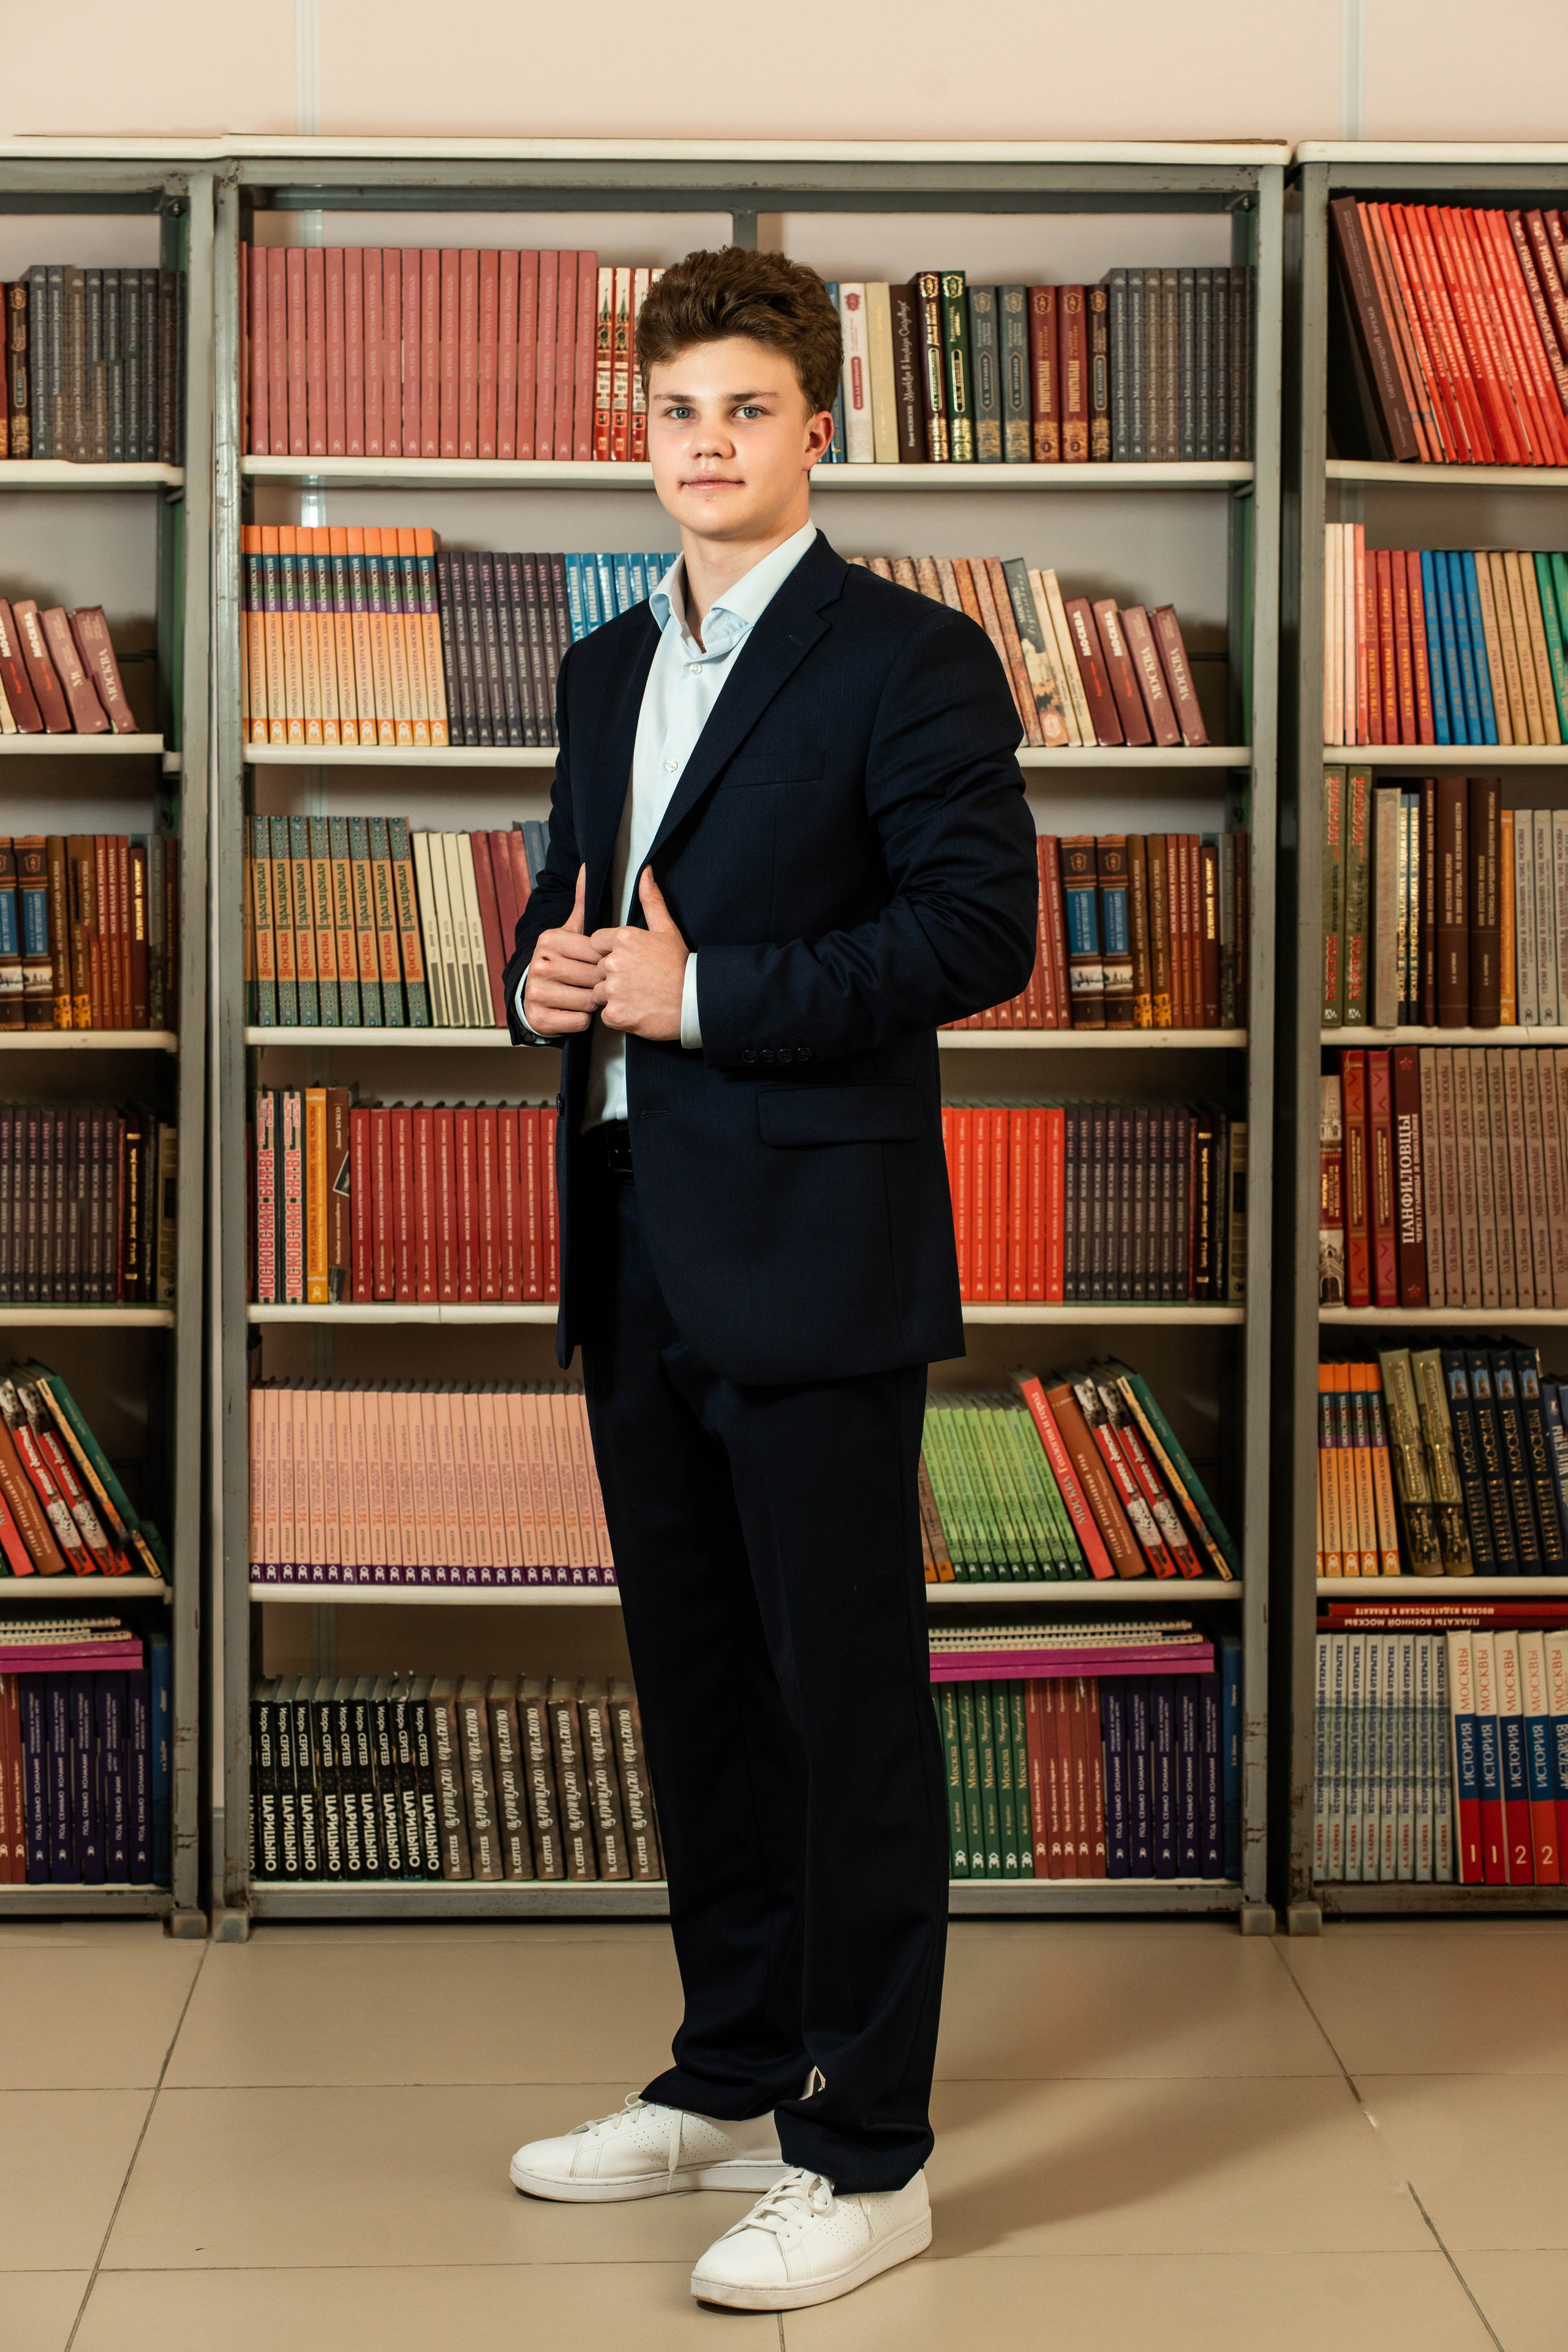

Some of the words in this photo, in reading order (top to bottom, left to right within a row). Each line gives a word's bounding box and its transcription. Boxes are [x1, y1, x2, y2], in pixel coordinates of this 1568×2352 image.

[569, 567, 582, 622] БЕЛОКАМЕННАЯ
[585, 567, 598, 622] БЕЛОКАМЕННАЯ
[24, 612, 42, 658] МОСКВА
[1073, 611, 1092, 656] МОСКВА
[1104, 611, 1123, 656] МОСКВА
[99, 648, 118, 702] МОСКВА
[460, 646, 469, 676] ПОДВИГ
[1141, 647, 1164, 699] МОСКВА
[1170, 648, 1189, 701] МОСКВА
[1326, 777, 1340, 845] МОСКВОЙ
[1351, 777, 1365, 845] МОСКВОЙ
[1325, 936, 1338, 1000] РАЗГРОМ
[1350, 936, 1362, 1000] РАЗГРОМ
[1426, 1110, 1434, 1138] ДОСКИ
[258, 1150, 274, 1198] БИТВА
[285, 1150, 301, 1198] БИТВА
[1398, 1115, 1415, 1243] ПАНФИЛОВЦЫ
[1427, 1145, 1436, 1216] МЕМОРИАЛЬНЫЕ
[257, 1203, 275, 1298] МОСКОВСКАЯ
[284, 1203, 302, 1298] МОСКОВСКАЯ
[1032, 1392, 1047, 1419] город
[1046, 1428, 1068, 1474] Геология
[1078, 1453, 1088, 1471] ХРАМ
[1457, 1410, 1477, 1472] МОСКВЫ
[1479, 1409, 1499, 1472] МОСКВЫ
[1063, 1476, 1087, 1525] МОСКВА
[1085, 1474, 1110, 1526] ПРАВОСЛАВНЫЙ
[1116, 1463, 1136, 1493] нашего
[1141, 1464, 1160, 1494] нашего
[1107, 1529, 1123, 1558] РУССКИЙ
[1400, 1607, 1460, 1616] ИЗДАТЕЛЬСКАЯ
[1458, 1648, 1470, 1710] МОСКВЫ
[1478, 1649, 1490, 1712] МОСКВЫ
[1504, 1649, 1517, 1711] МОСКВЫ
[1528, 1650, 1541, 1712] МОСКВЫ
[260, 1707, 269, 1732] Игорь
[262, 1734, 271, 1766] СЕРГЕЕВ
[281, 1734, 290, 1766] СЕРГЕЕВ
[322, 1734, 333, 1766] СЕРГЕЕВ
[950, 1746, 959, 1786] Москва
[967, 1749, 977, 1789] Москва
[1461, 1724, 1474, 1786] ИСТОРИЯ
[1482, 1725, 1495, 1787] ИСТОРИЯ
[1508, 1725, 1522, 1787] ИСТОРИЯ
[1532, 1725, 1547, 1787] ИСТОРИЯ
[262, 1795, 277, 1871] ЦАРИЦЫНО
[282, 1795, 297, 1871] ЦАРИЦЫНО
[325, 1795, 341, 1871] ЦАРИЦЫНО
[1471, 1844, 1476, 1863] 1
[1491, 1845, 1497, 1863] 1
[1515, 1845, 1526, 1864] 2
[1541, 1845, 1553, 1864] 2
